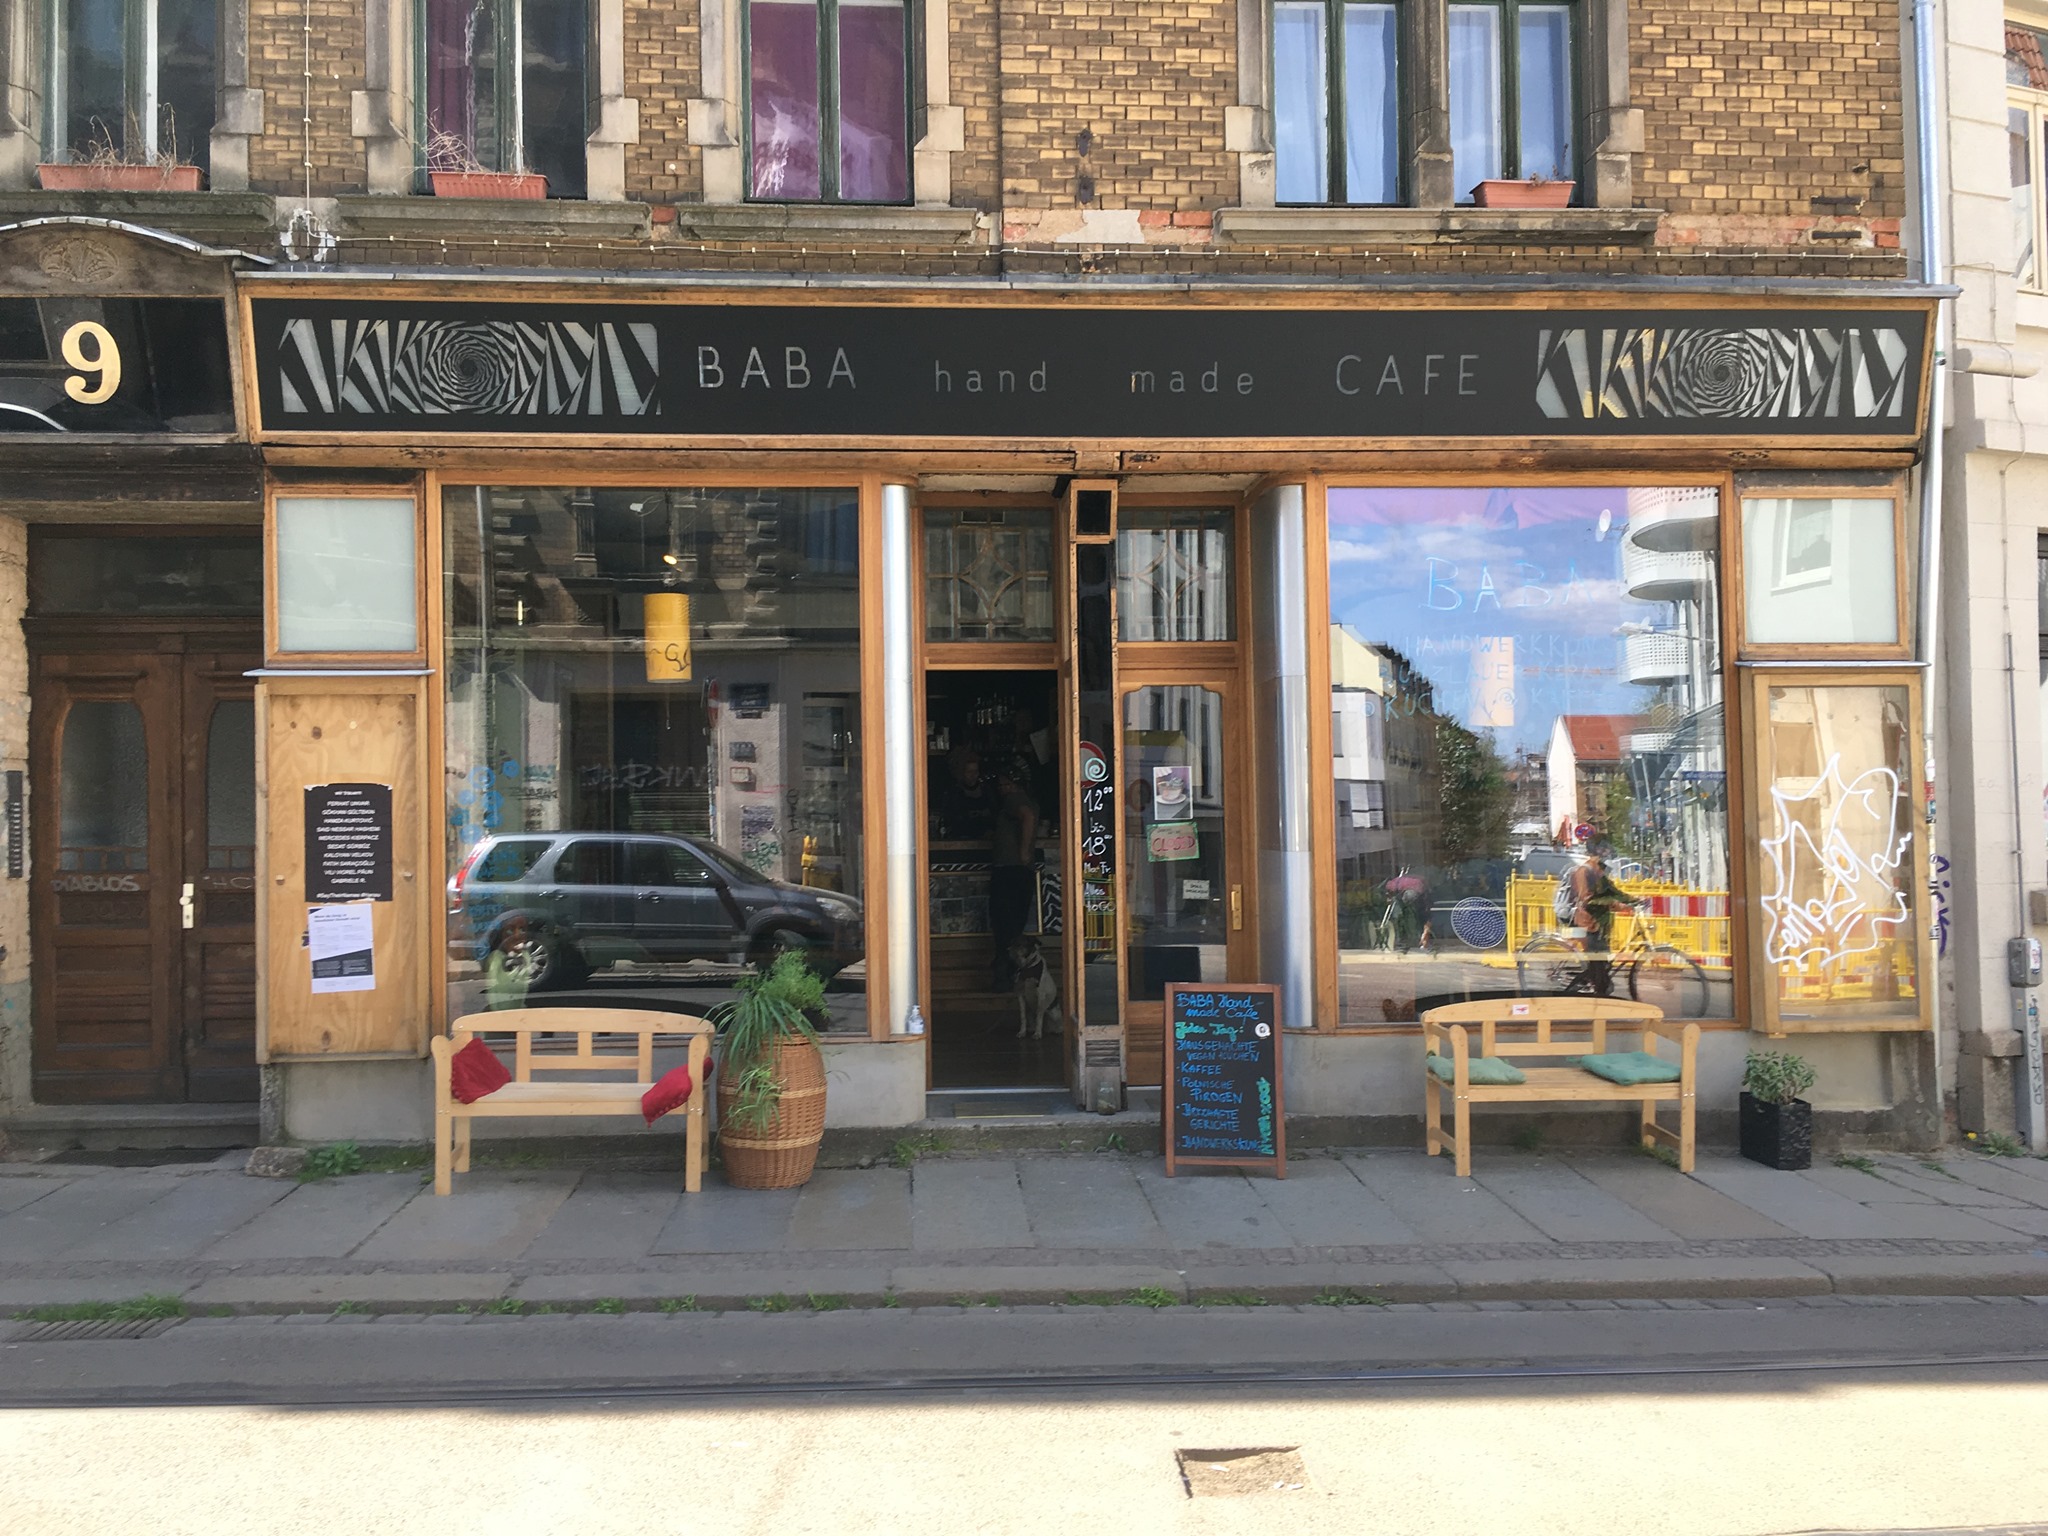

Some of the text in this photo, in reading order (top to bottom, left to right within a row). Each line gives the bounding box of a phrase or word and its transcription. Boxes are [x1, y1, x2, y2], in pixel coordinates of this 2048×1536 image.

[62, 321, 121, 404] 9
[697, 345, 1481, 396] BABA hand made CAFE
[1419, 556, 1593, 613] BABA
[1090, 817, 1106, 833] bis
[1152, 835, 1196, 852] CLOSED
[1084, 883, 1105, 896] Alles
[1176, 993, 1215, 1008] BABA
[1185, 1008, 1220, 1018] made
[1175, 1022, 1244, 1042] Jeden Tag:
[1186, 1052, 1216, 1060] VEGAN
[1181, 1062, 1222, 1075] KAFFEE
[1182, 1077, 1235, 1090] POLNISCHE
[1190, 1087, 1243, 1104] PIROGEN
[1190, 1118, 1240, 1132] GERICHTE
